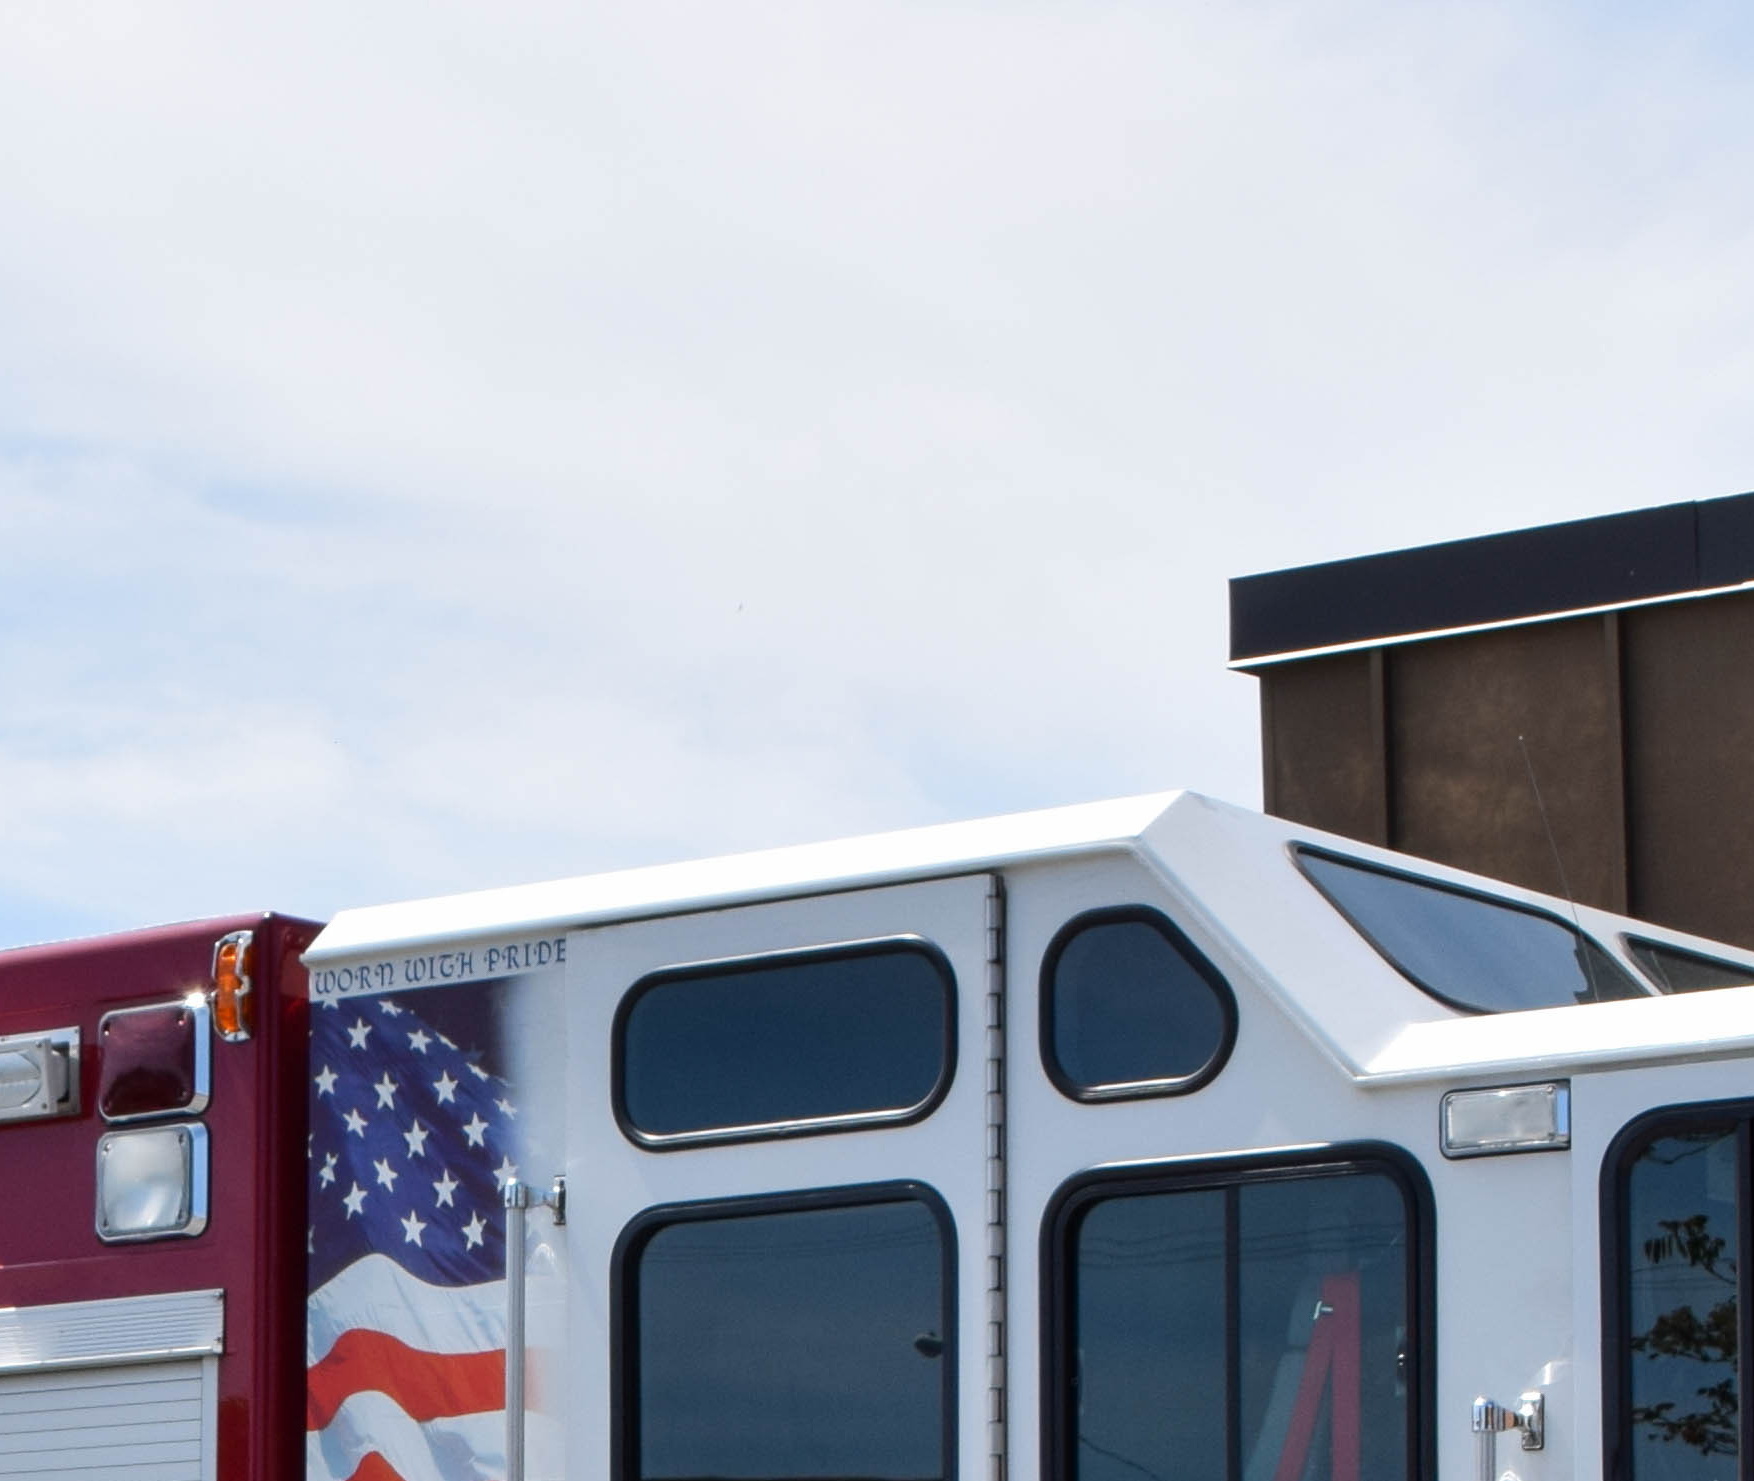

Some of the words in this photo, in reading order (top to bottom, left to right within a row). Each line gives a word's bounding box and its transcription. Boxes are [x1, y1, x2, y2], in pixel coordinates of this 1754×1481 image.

[313, 963, 394, 995] WORN
[404, 952, 473, 983] WITH
[482, 937, 567, 971] PRIDE
